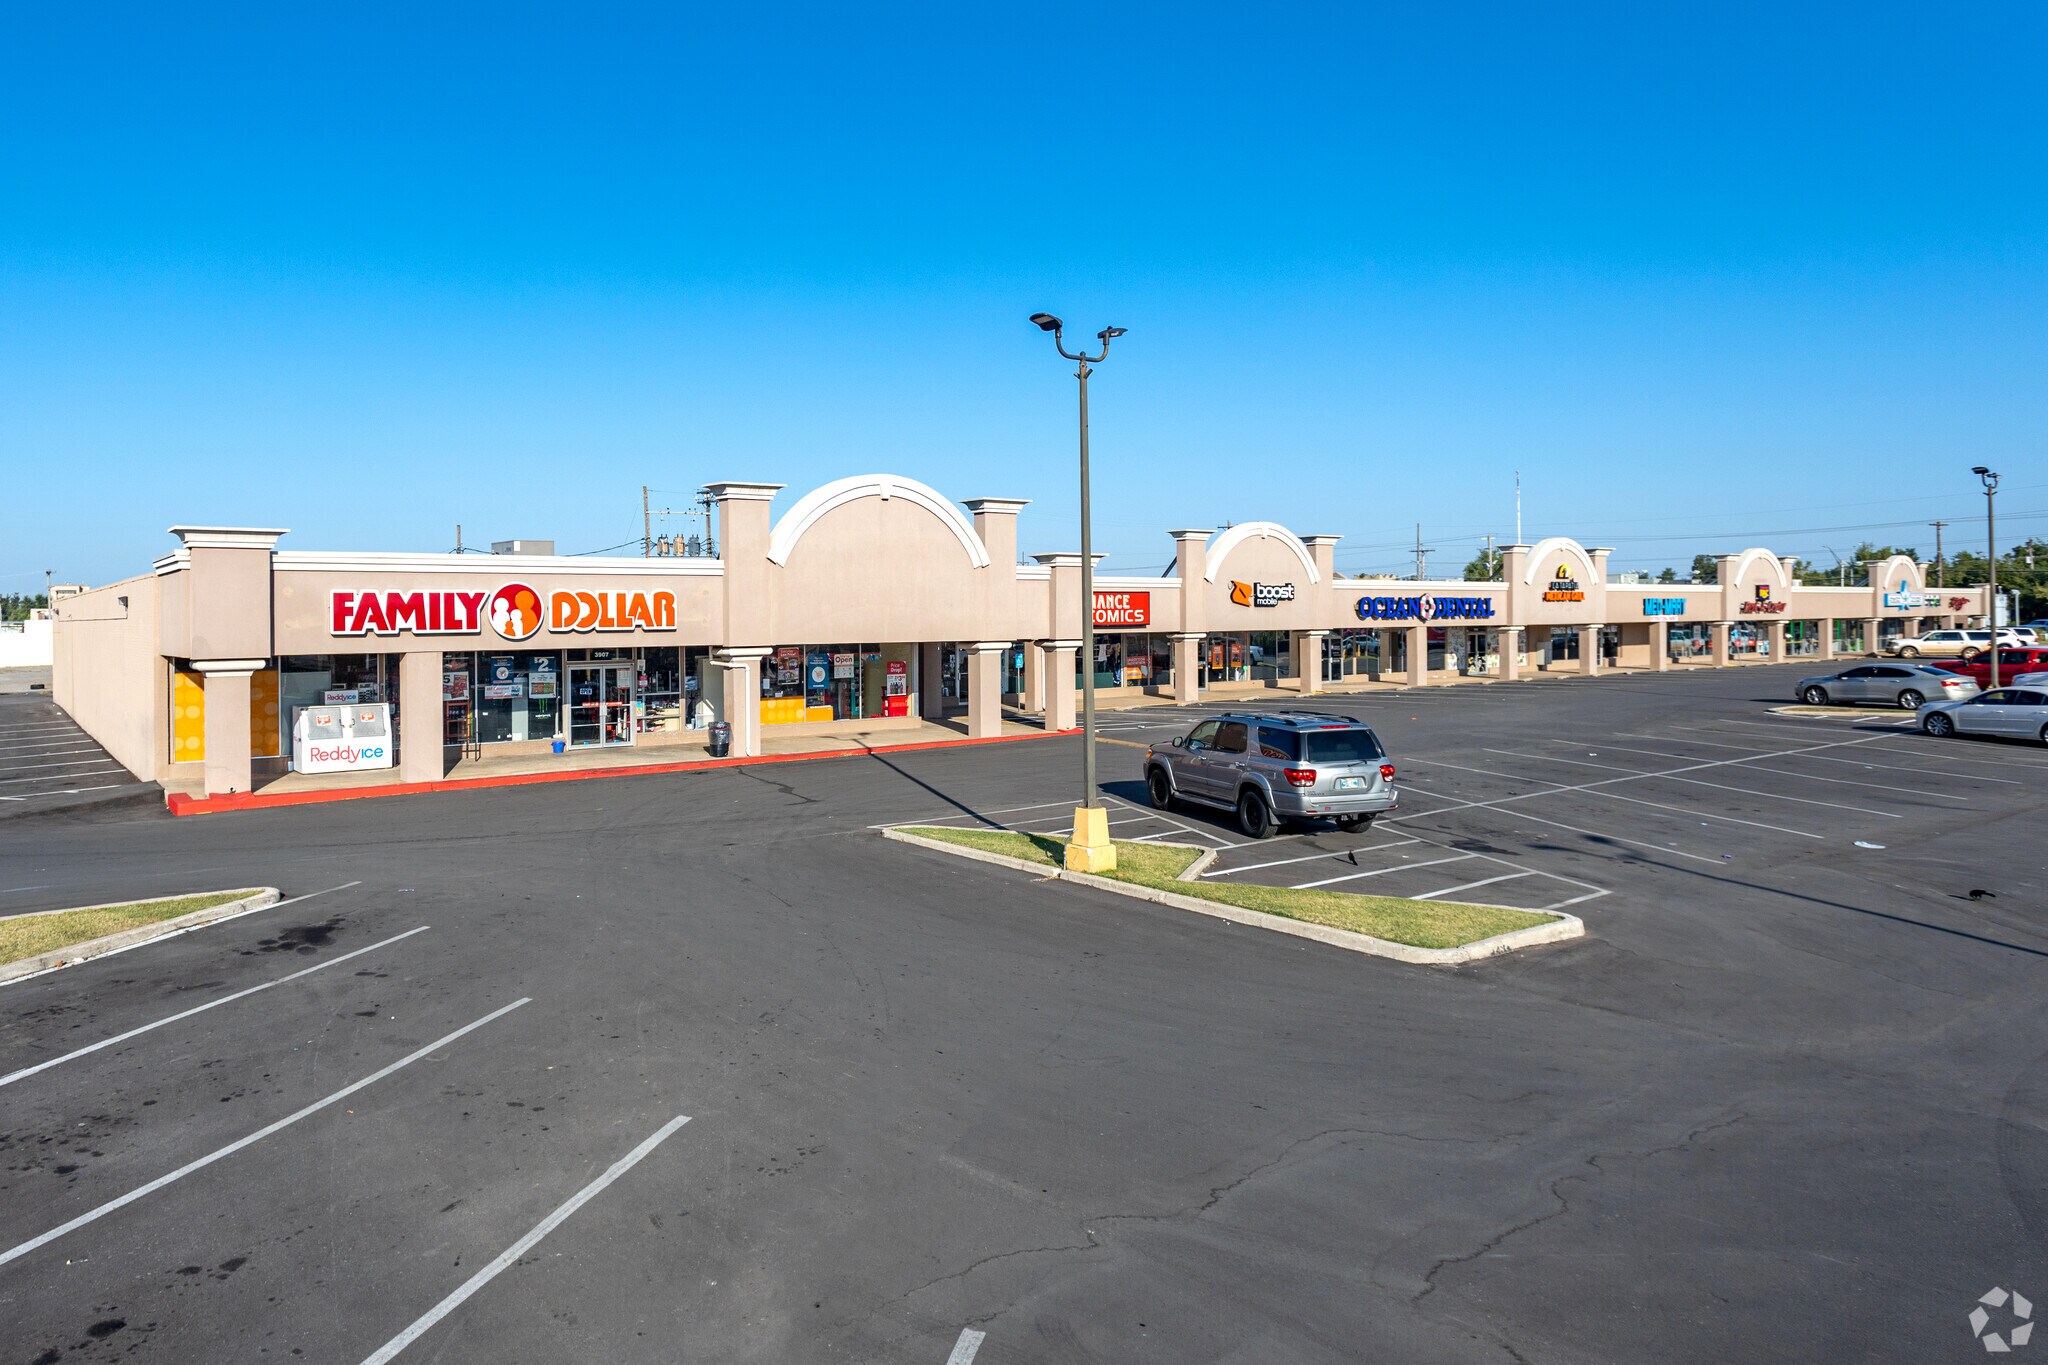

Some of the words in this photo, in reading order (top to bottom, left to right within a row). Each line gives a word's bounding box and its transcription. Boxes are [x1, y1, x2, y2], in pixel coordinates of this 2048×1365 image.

[1257, 583, 1294, 598] boost
[333, 592, 484, 631] FAMILY
[551, 591, 675, 629] DOLLAR
[1359, 596, 1421, 617] OCEAN
[1435, 597, 1496, 617] DENTAL
[835, 656, 852, 664] Open
